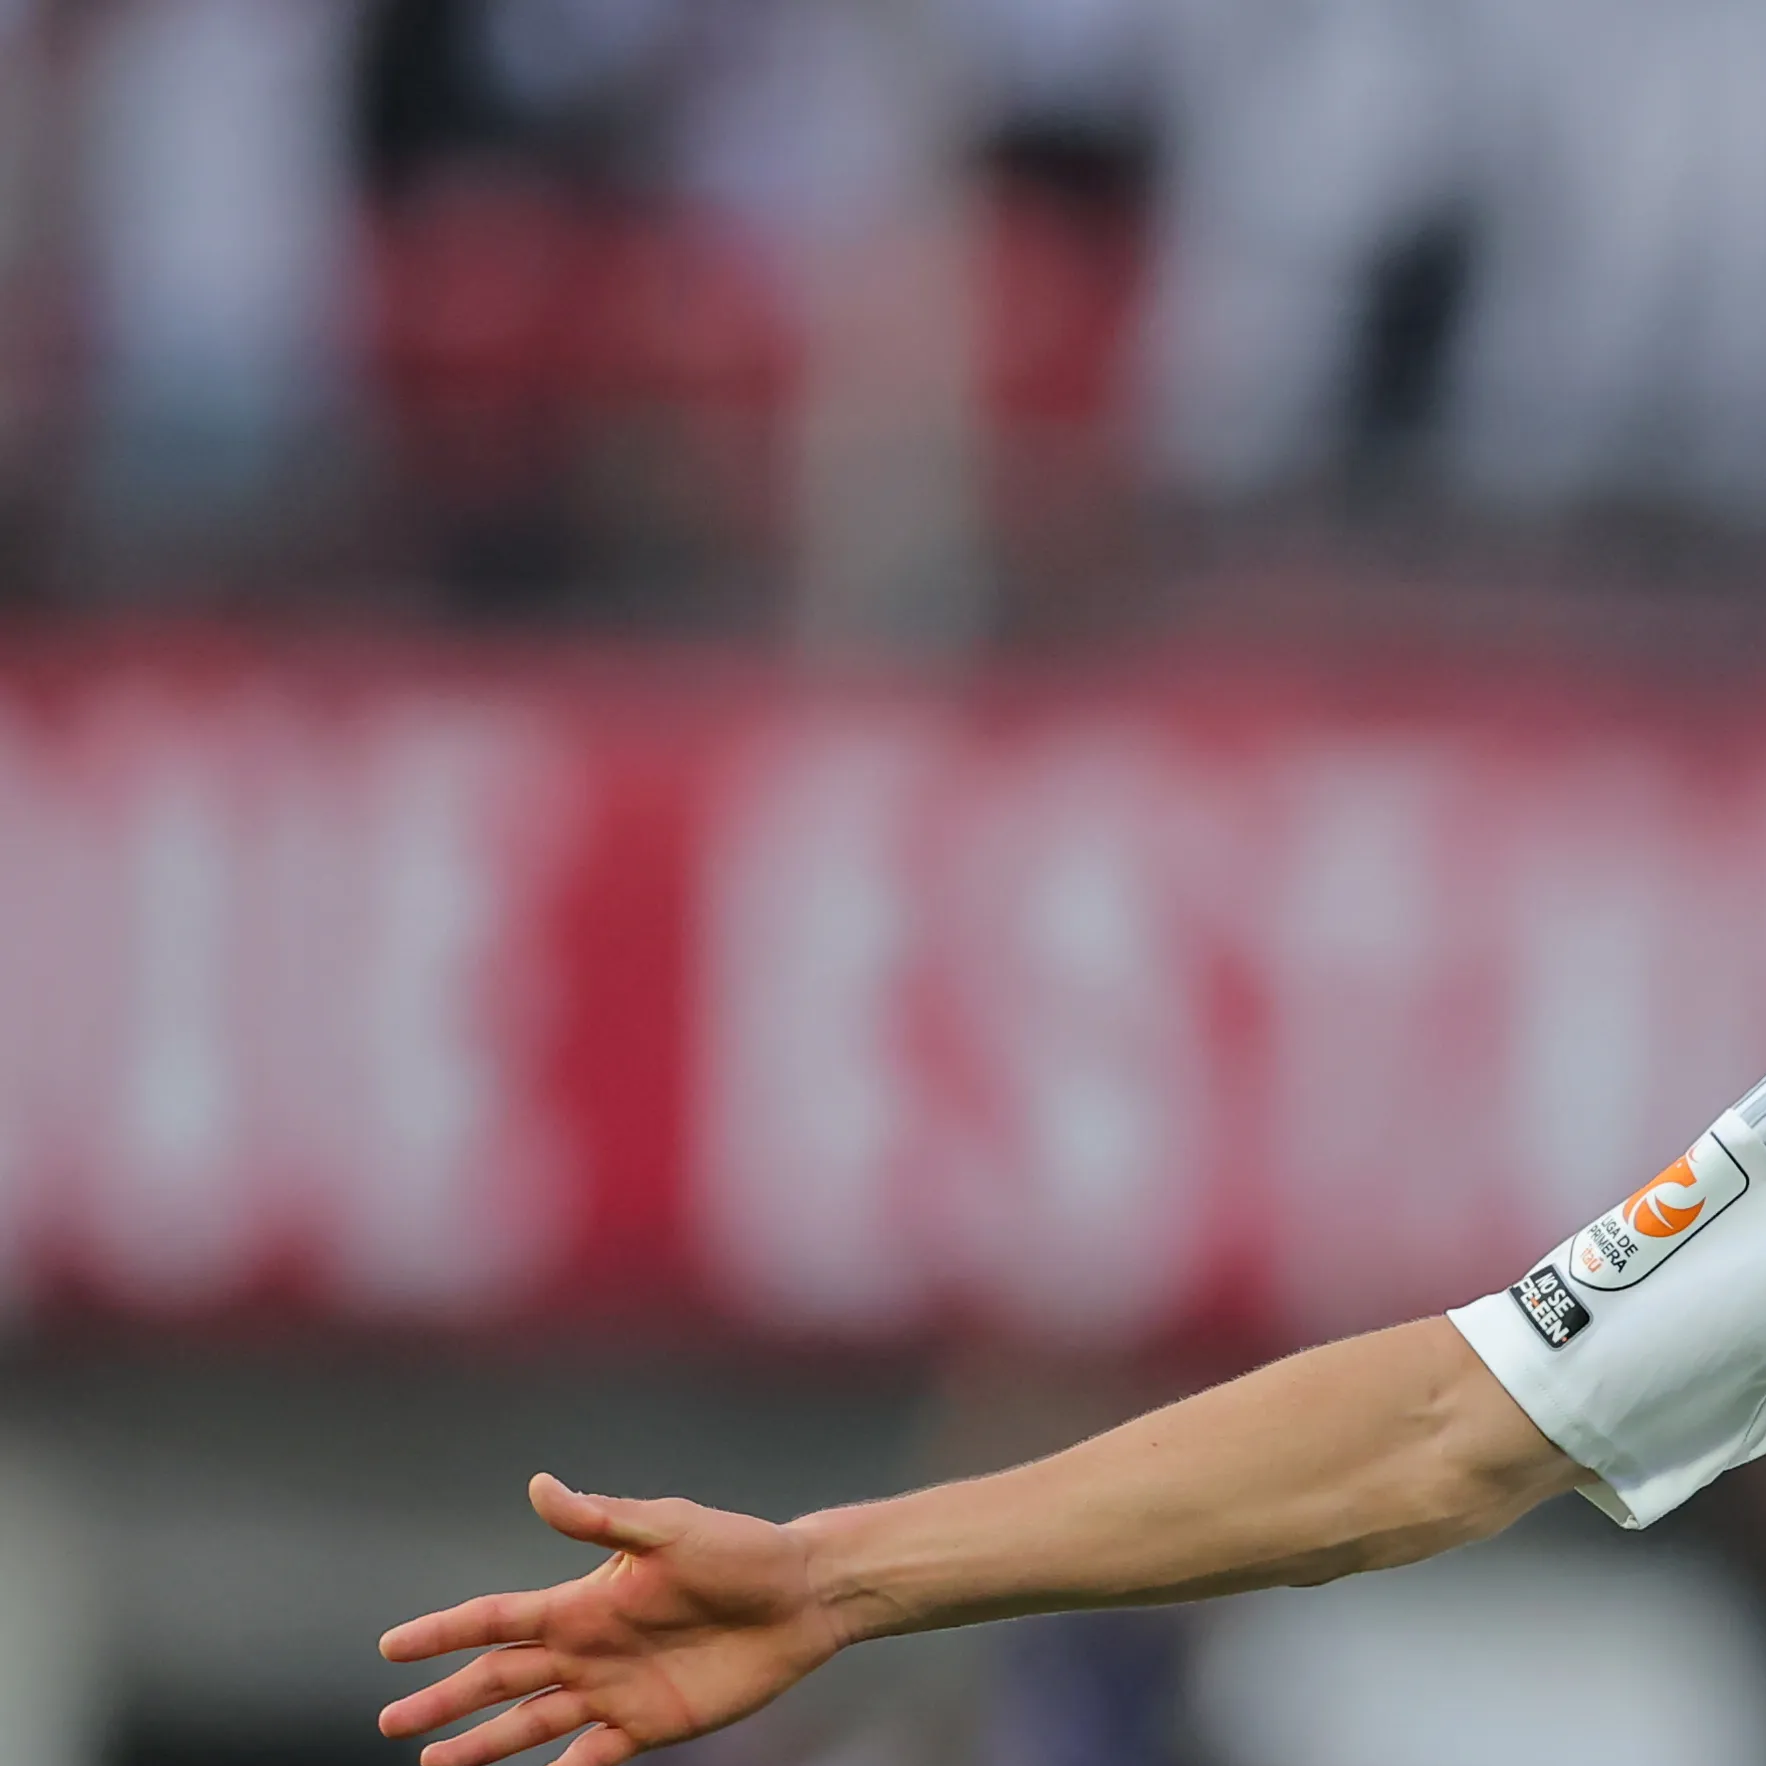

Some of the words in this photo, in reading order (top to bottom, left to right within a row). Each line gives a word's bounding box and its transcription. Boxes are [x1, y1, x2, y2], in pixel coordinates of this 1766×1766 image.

[1587, 1224, 1627, 1273] PRIMERA
[1601, 1215, 1621, 1239] LIGA
[1617, 1235, 1639, 1257] DE
[1535, 1272, 1558, 1294] NO
[1547, 1289, 1575, 1317] SE
